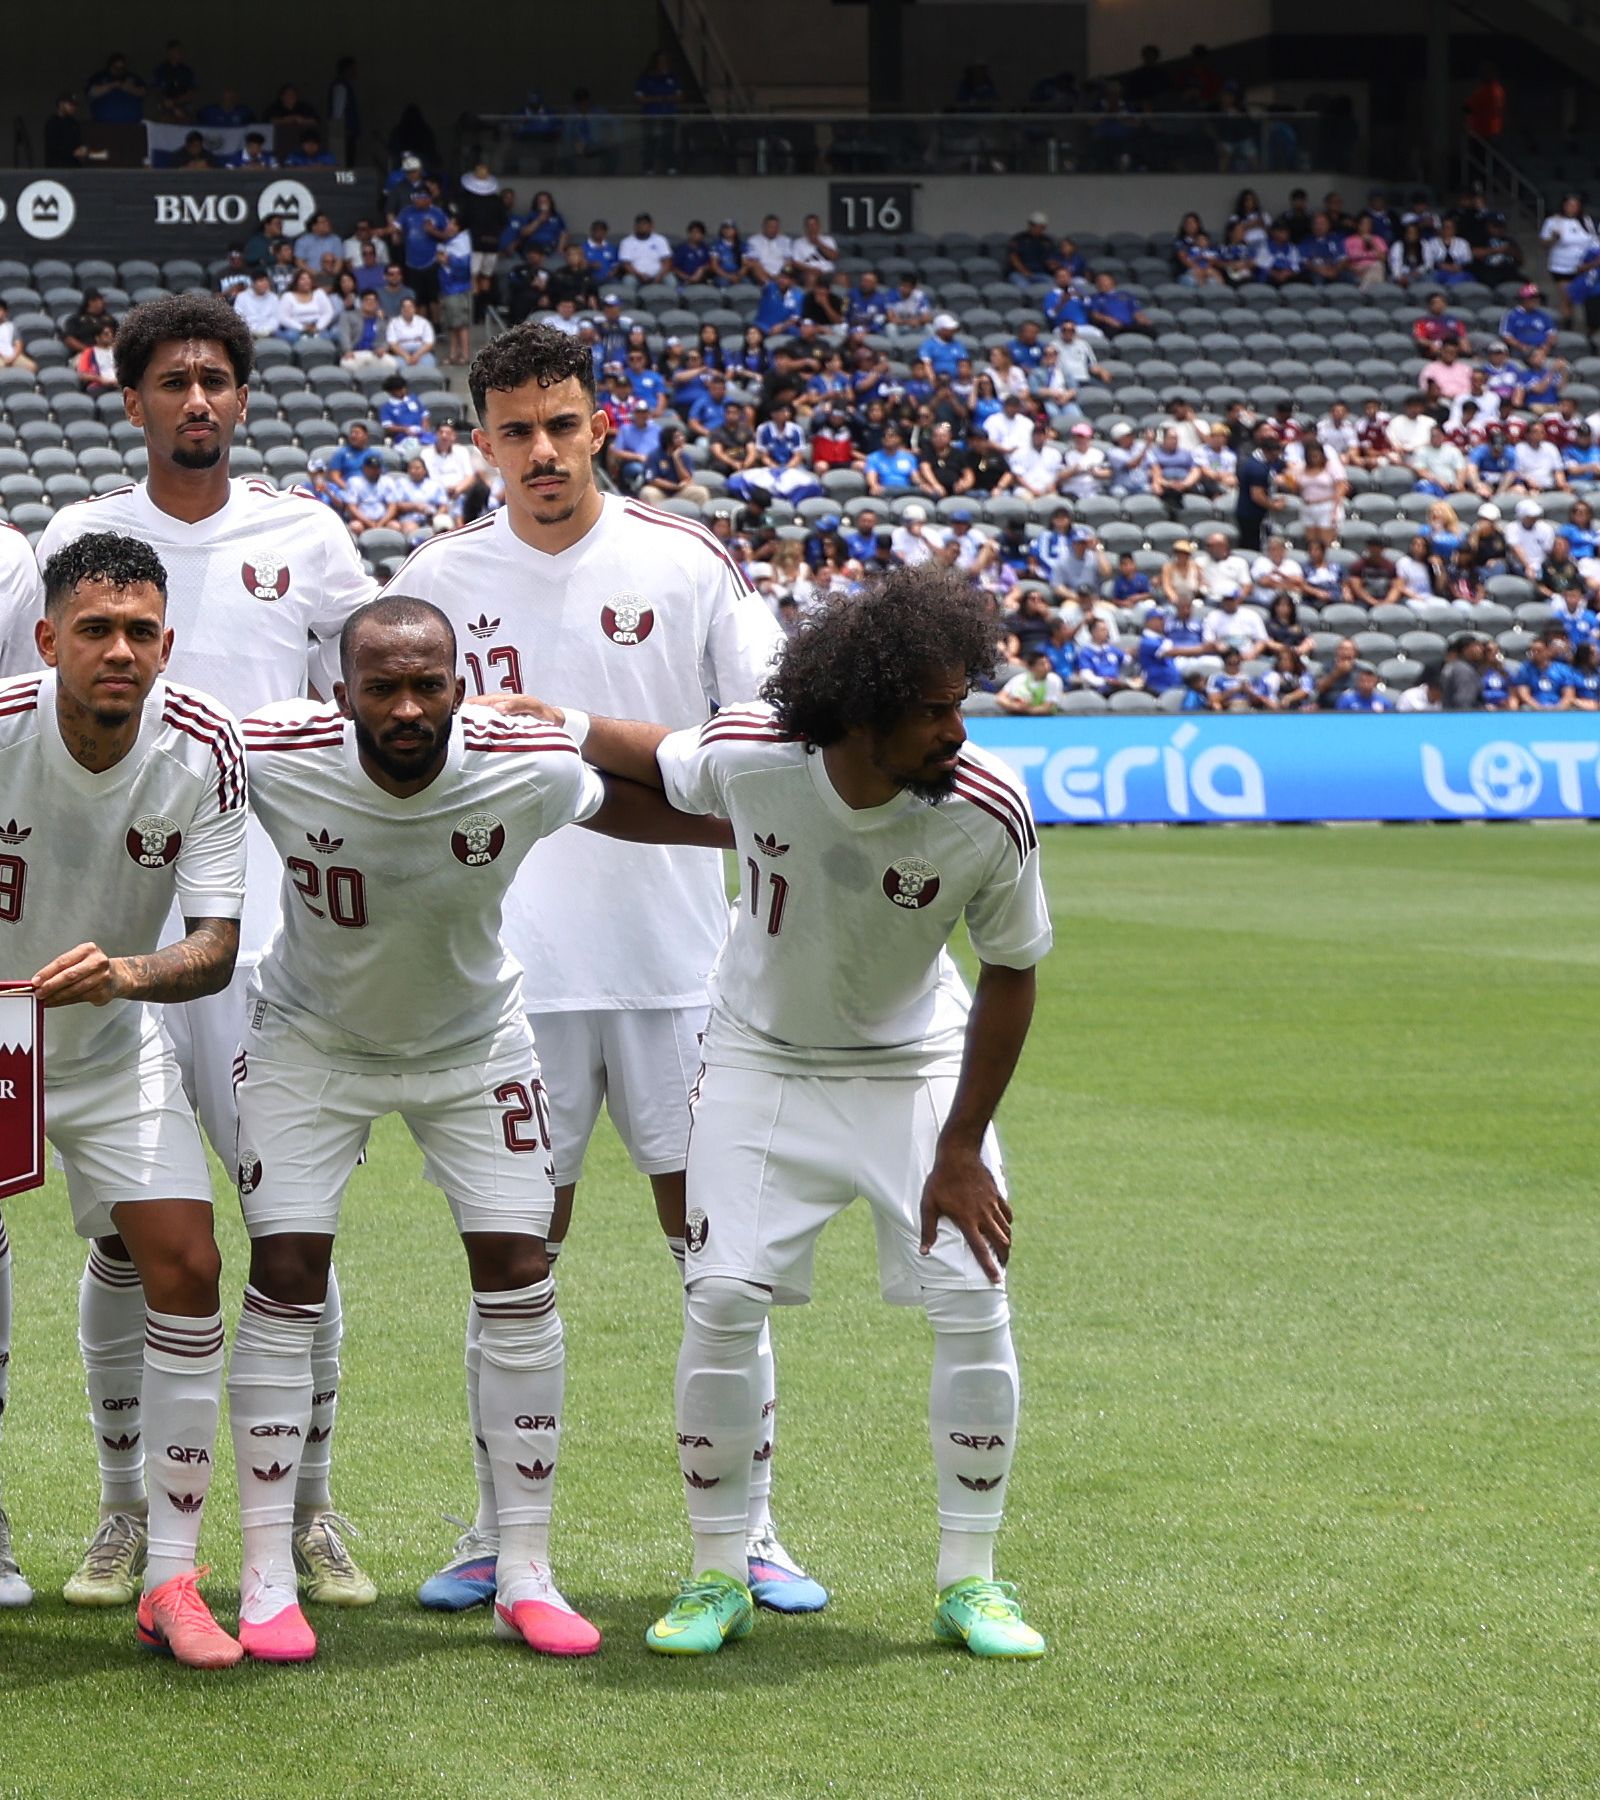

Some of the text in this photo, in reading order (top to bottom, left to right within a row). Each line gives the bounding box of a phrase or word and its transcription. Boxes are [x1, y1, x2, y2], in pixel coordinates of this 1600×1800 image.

[154, 194, 248, 224] BMO
[840, 196, 902, 231] 116
[612, 631, 639, 644] QFA
[1420, 740, 1600, 815] LOT
[138, 855, 166, 867] QFA
[466, 852, 492, 865] QFA
[286, 855, 369, 930] 20
[747, 856, 790, 938] 11
[893, 893, 919, 908] QFA
[102, 1396, 140, 1412] QFA
[249, 1424, 300, 1437] QFA
[514, 1415, 556, 1430] QFA
[949, 1432, 1006, 1450] QFA
[166, 1445, 210, 1464] QFA
